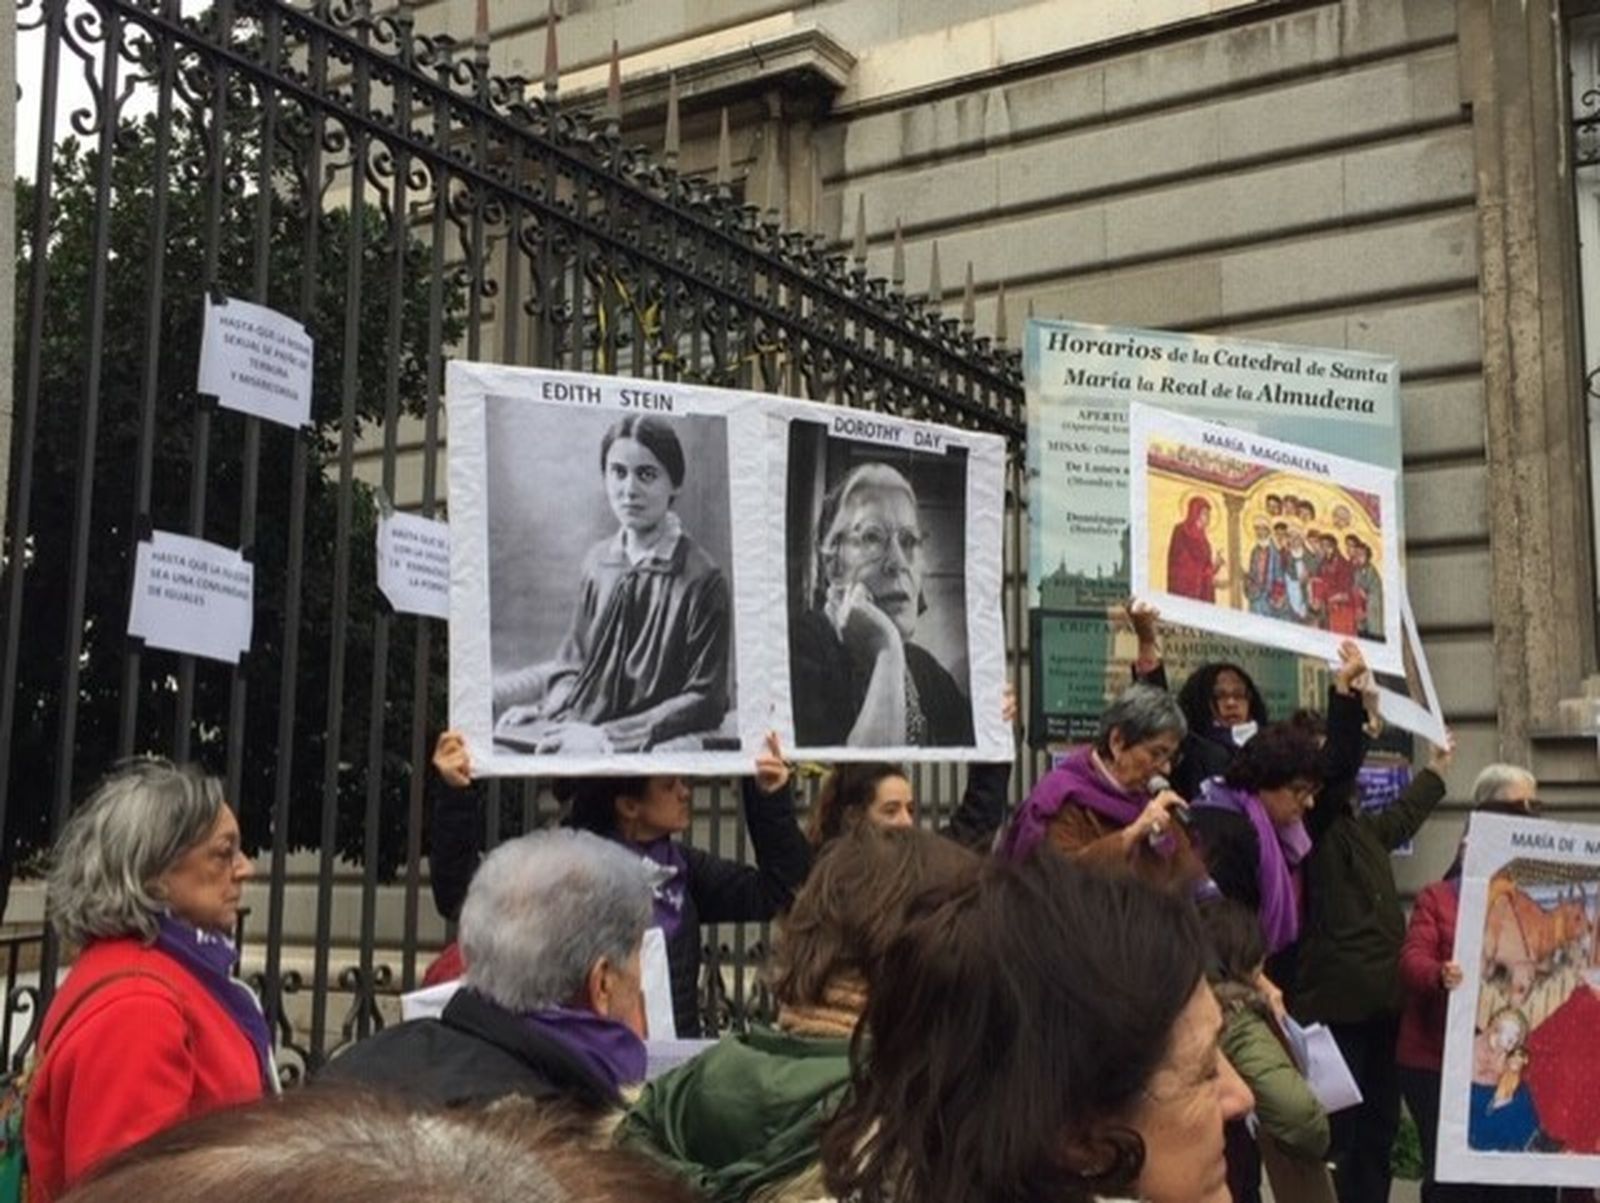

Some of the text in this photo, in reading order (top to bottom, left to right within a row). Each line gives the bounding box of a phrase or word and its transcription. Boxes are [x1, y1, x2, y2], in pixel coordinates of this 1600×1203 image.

[1048, 332, 1388, 384] Horarios de la Catedral de Santa
[542, 381, 674, 411] EDITH STEIN
[1064, 368, 1375, 413] María la Real de la Almudena
[834, 416, 942, 449] DOROTHY DAY
[1250, 444, 1331, 475] MAGDALENA
[151, 551, 187, 567] HASTA
[1511, 831, 1555, 849] MARÍA
[1557, 836, 1574, 853] DE
